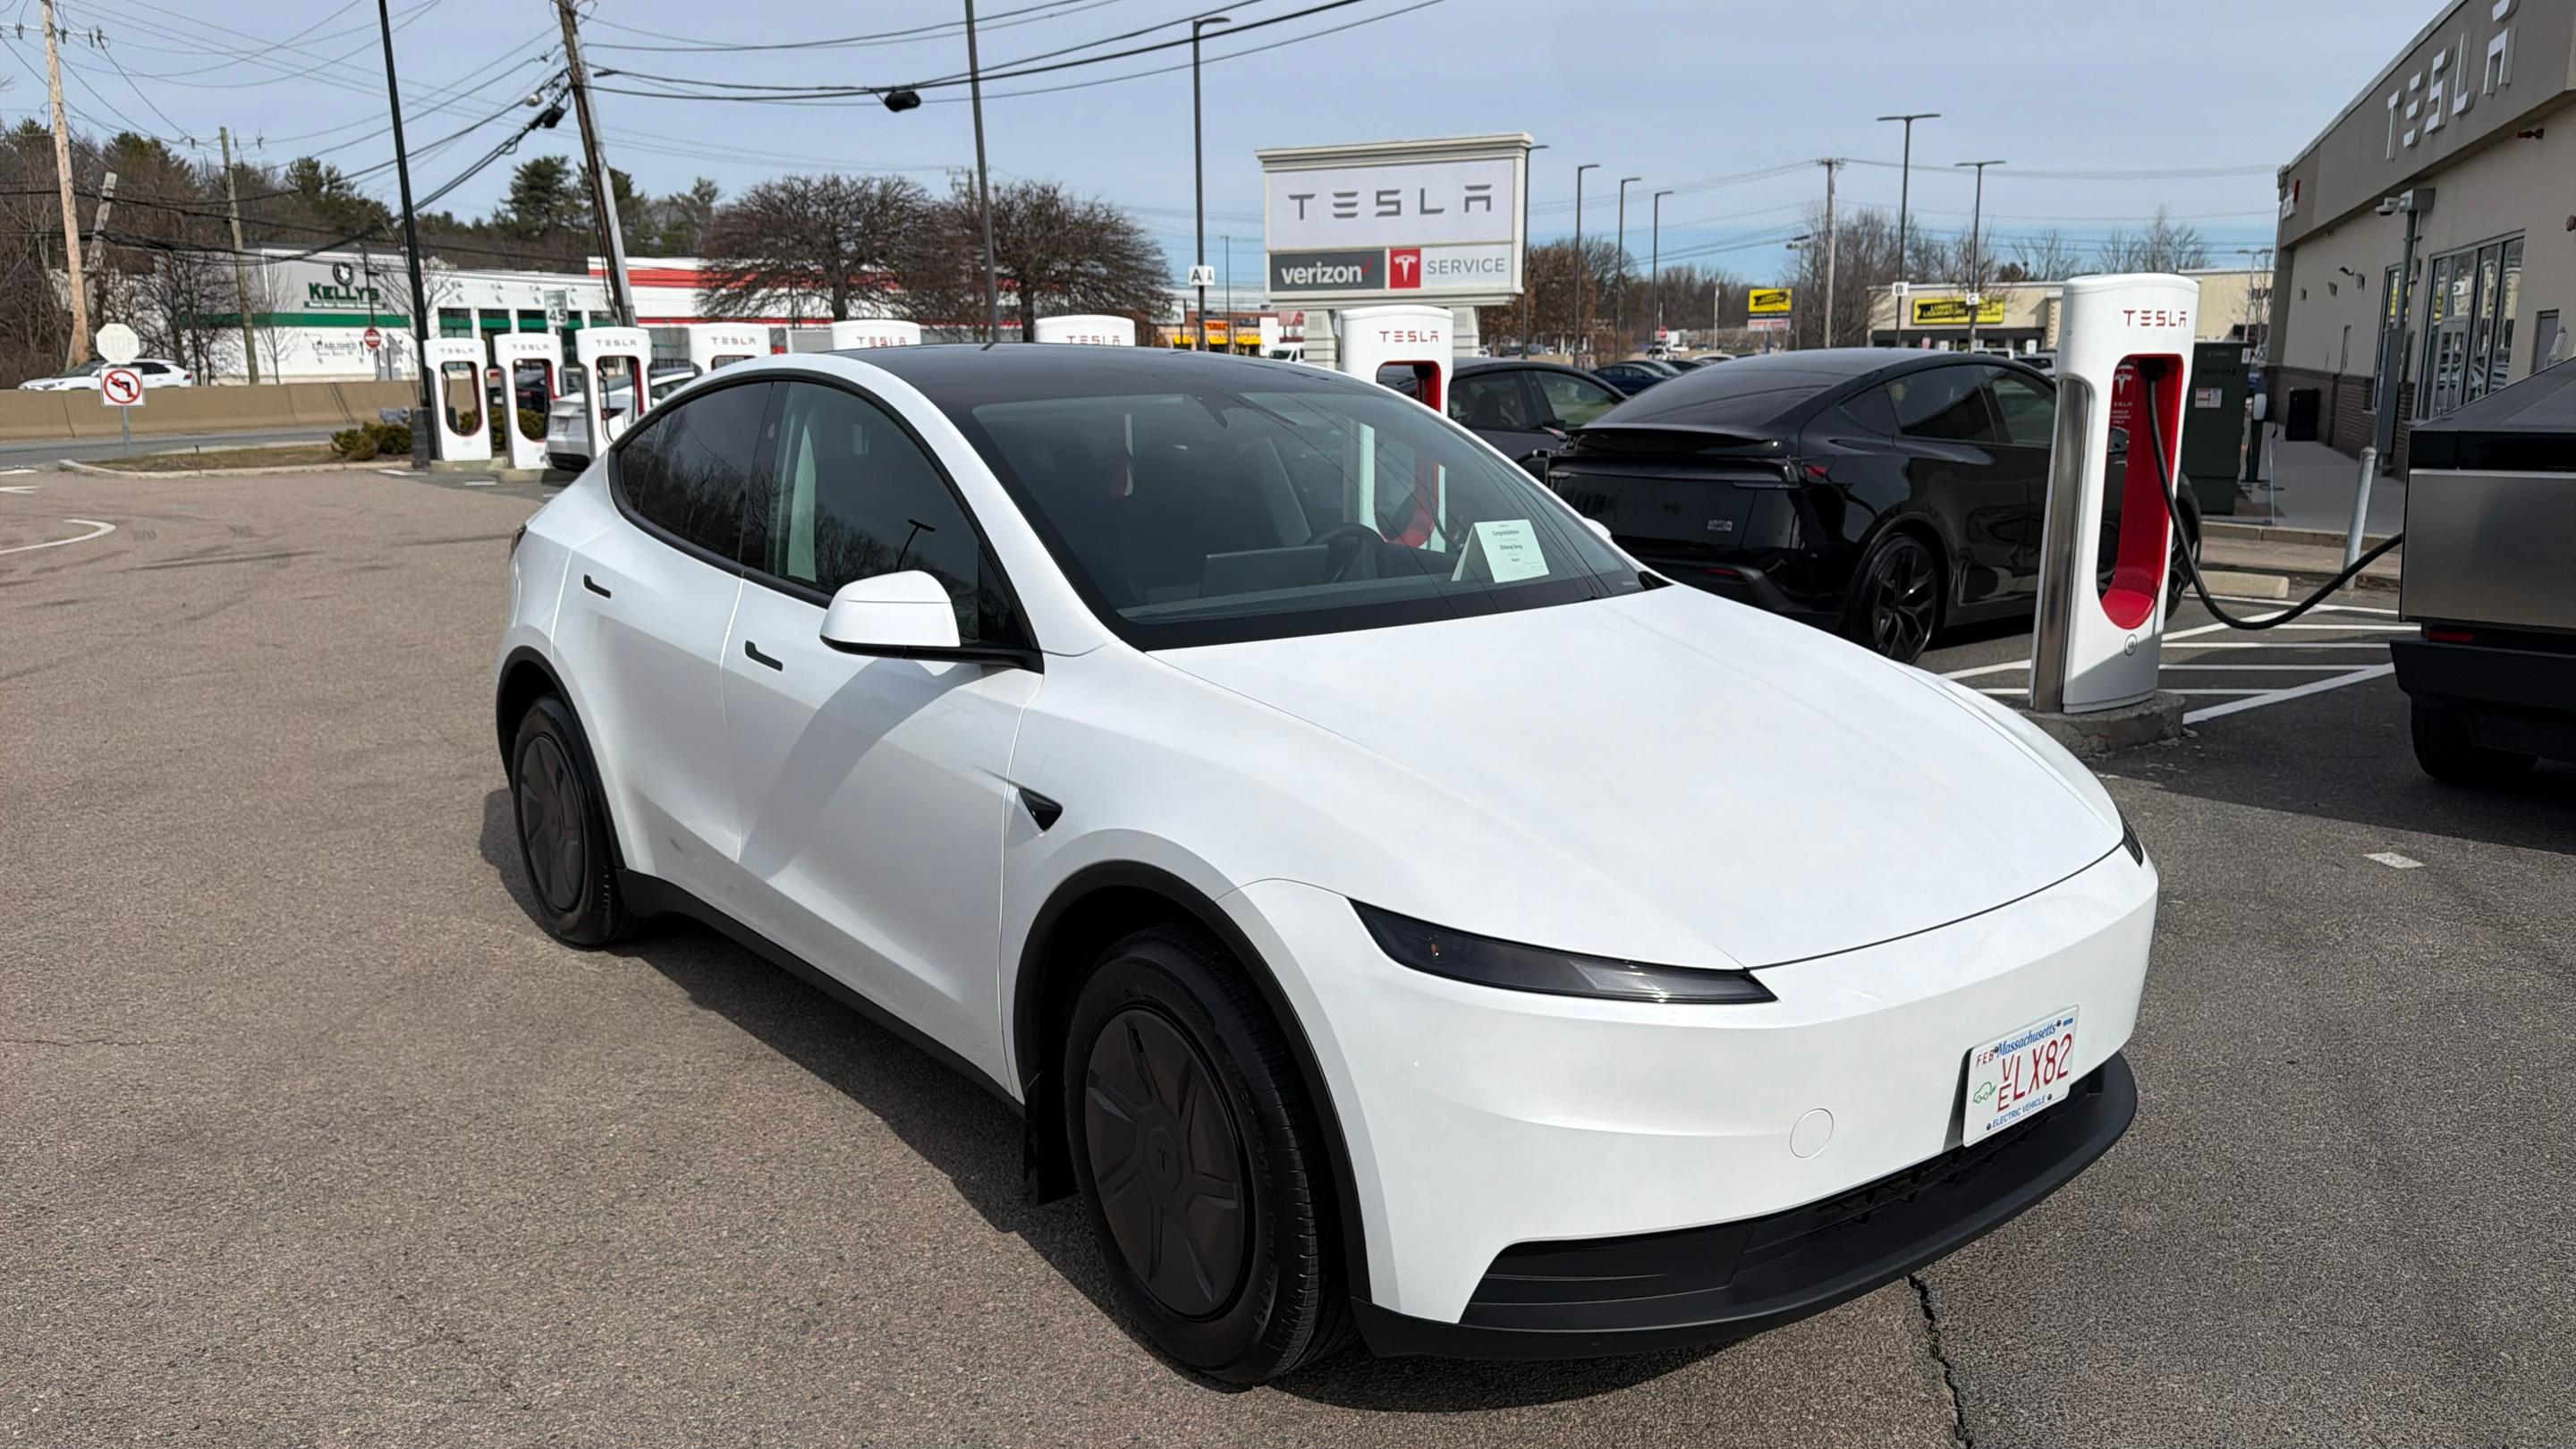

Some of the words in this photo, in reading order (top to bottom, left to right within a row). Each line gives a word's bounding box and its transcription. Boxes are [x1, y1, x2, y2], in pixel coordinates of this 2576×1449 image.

[2386, 0, 2515, 160] TESLA
[1288, 184, 1492, 220] TESLA
[1281, 261, 1362, 284] verizon
[1428, 258, 1505, 275] SERVICE
[1191, 269, 1202, 282] A
[1207, 269, 1213, 282] A
[1968, 295, 1975, 303] C
[549, 309, 566, 322] 45
[2123, 310, 2187, 326] TESLA
[596, 339, 637, 347] TESLA
[711, 336, 756, 345] TESLA
[856, 336, 907, 347] TESLA
[1066, 335, 1120, 345] TESLA
[1379, 331, 1438, 342] TESLA
[1997, 1023, 2057, 1057] Massachusetts
[1976, 1050, 1995, 1068] FEB
[1993, 1107, 2021, 1128] ELECTRIC
[2022, 1095, 2046, 1114] VEHICLE
